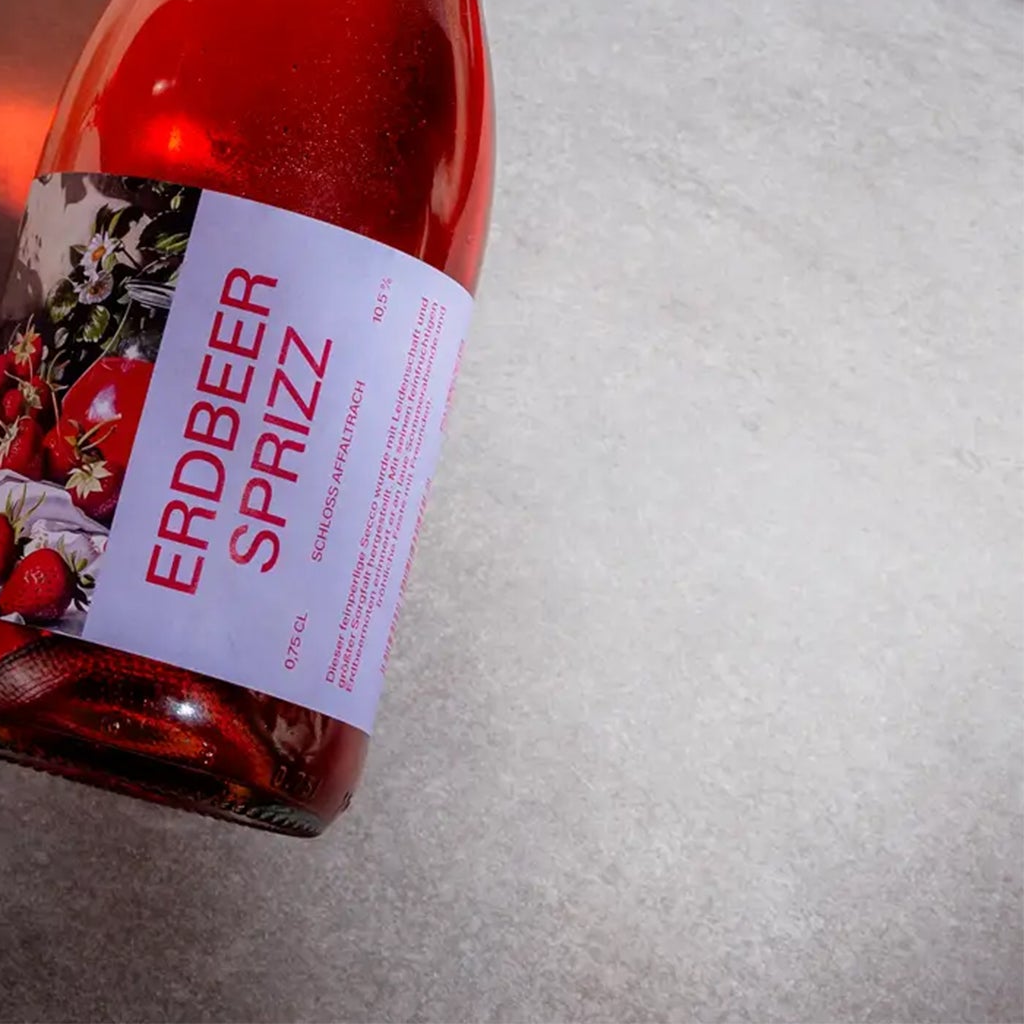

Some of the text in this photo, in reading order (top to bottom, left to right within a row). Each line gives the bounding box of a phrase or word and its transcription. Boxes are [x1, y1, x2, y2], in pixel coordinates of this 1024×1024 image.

[373, 277, 393, 323] 10,5 %
[145, 267, 278, 596] ERDBEER
[227, 326, 334, 573] SPRIZZ
[311, 379, 366, 563] SCHLOSS AFFALTRACH
[325, 296, 429, 683] Dieser feinperlige Secco wurde mit Leidenschaft und
[338, 632, 357, 689] größter
[351, 569, 371, 629] Sorgfalt
[388, 457, 399, 480] Mit
[396, 405, 412, 454] seinen
[408, 301, 438, 402] feinfruchtigen
[284, 611, 308, 670] 0,75 CL
[345, 590, 377, 692] Erdbeernoten
